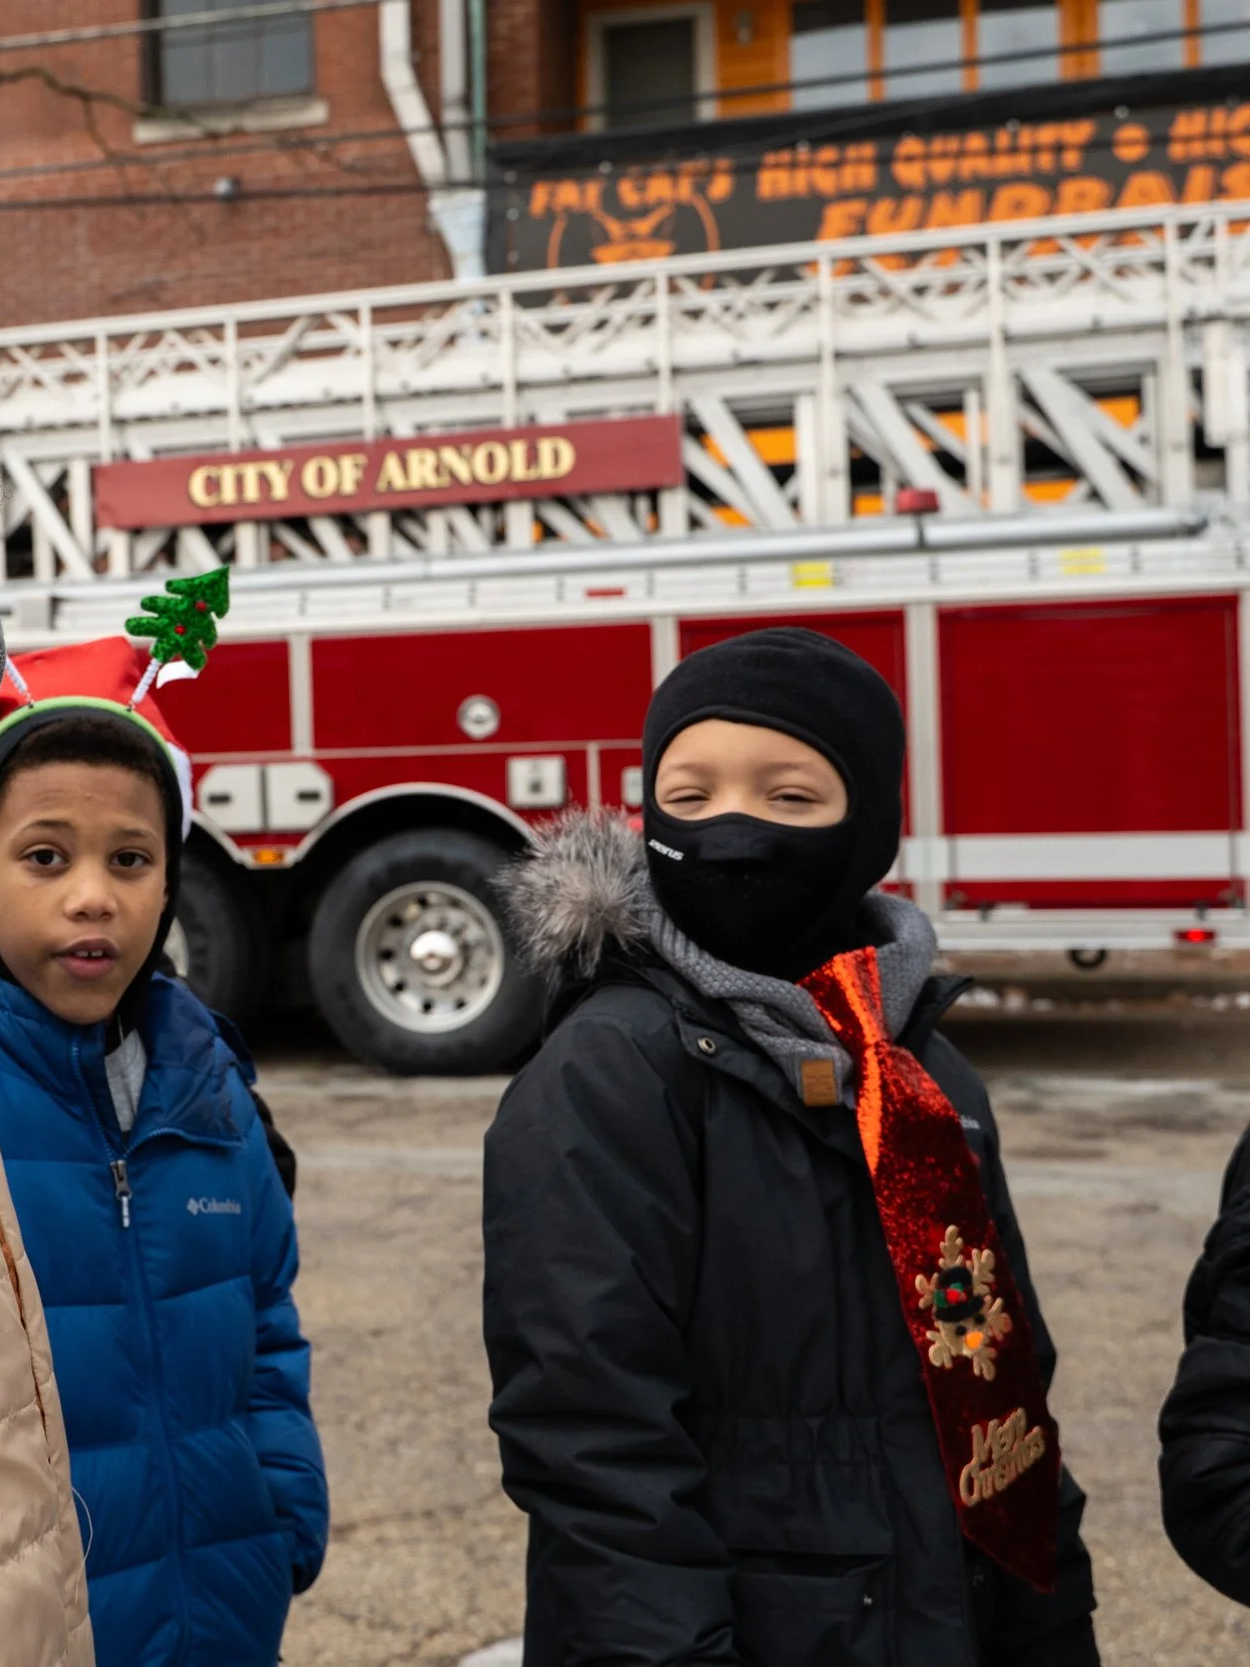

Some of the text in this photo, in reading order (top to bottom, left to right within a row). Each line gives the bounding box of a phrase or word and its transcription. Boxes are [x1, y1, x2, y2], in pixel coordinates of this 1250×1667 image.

[755, 139, 879, 203] HIGH
[891, 116, 1097, 192] QUALITY
[188, 435, 576, 507] CITY OF ARNOLD
